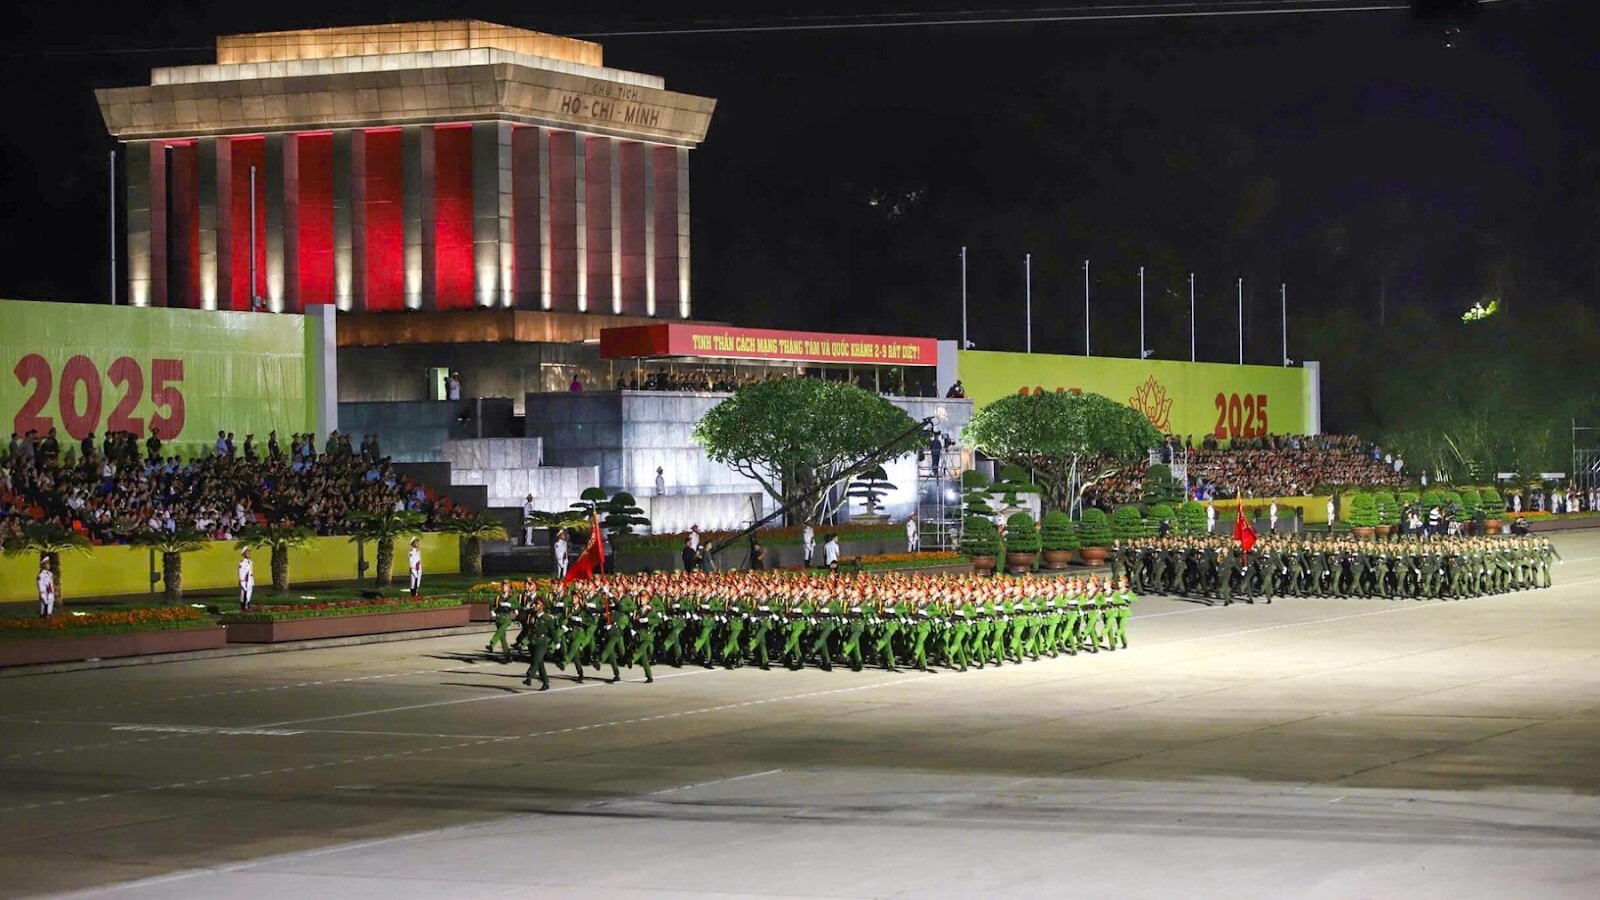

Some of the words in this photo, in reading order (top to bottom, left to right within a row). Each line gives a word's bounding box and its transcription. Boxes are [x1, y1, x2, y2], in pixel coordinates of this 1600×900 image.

[692, 335, 711, 350] TINH
[736, 334, 756, 353] CÁCH
[757, 337, 777, 356] MẠNG
[779, 336, 803, 355] THÁNG
[831, 338, 849, 357] QUỐC
[850, 340, 873, 358] KHÁNH
[874, 344, 887, 358] 2-9
[13, 353, 185, 441] 2025
[1215, 392, 1268, 439] 2025
